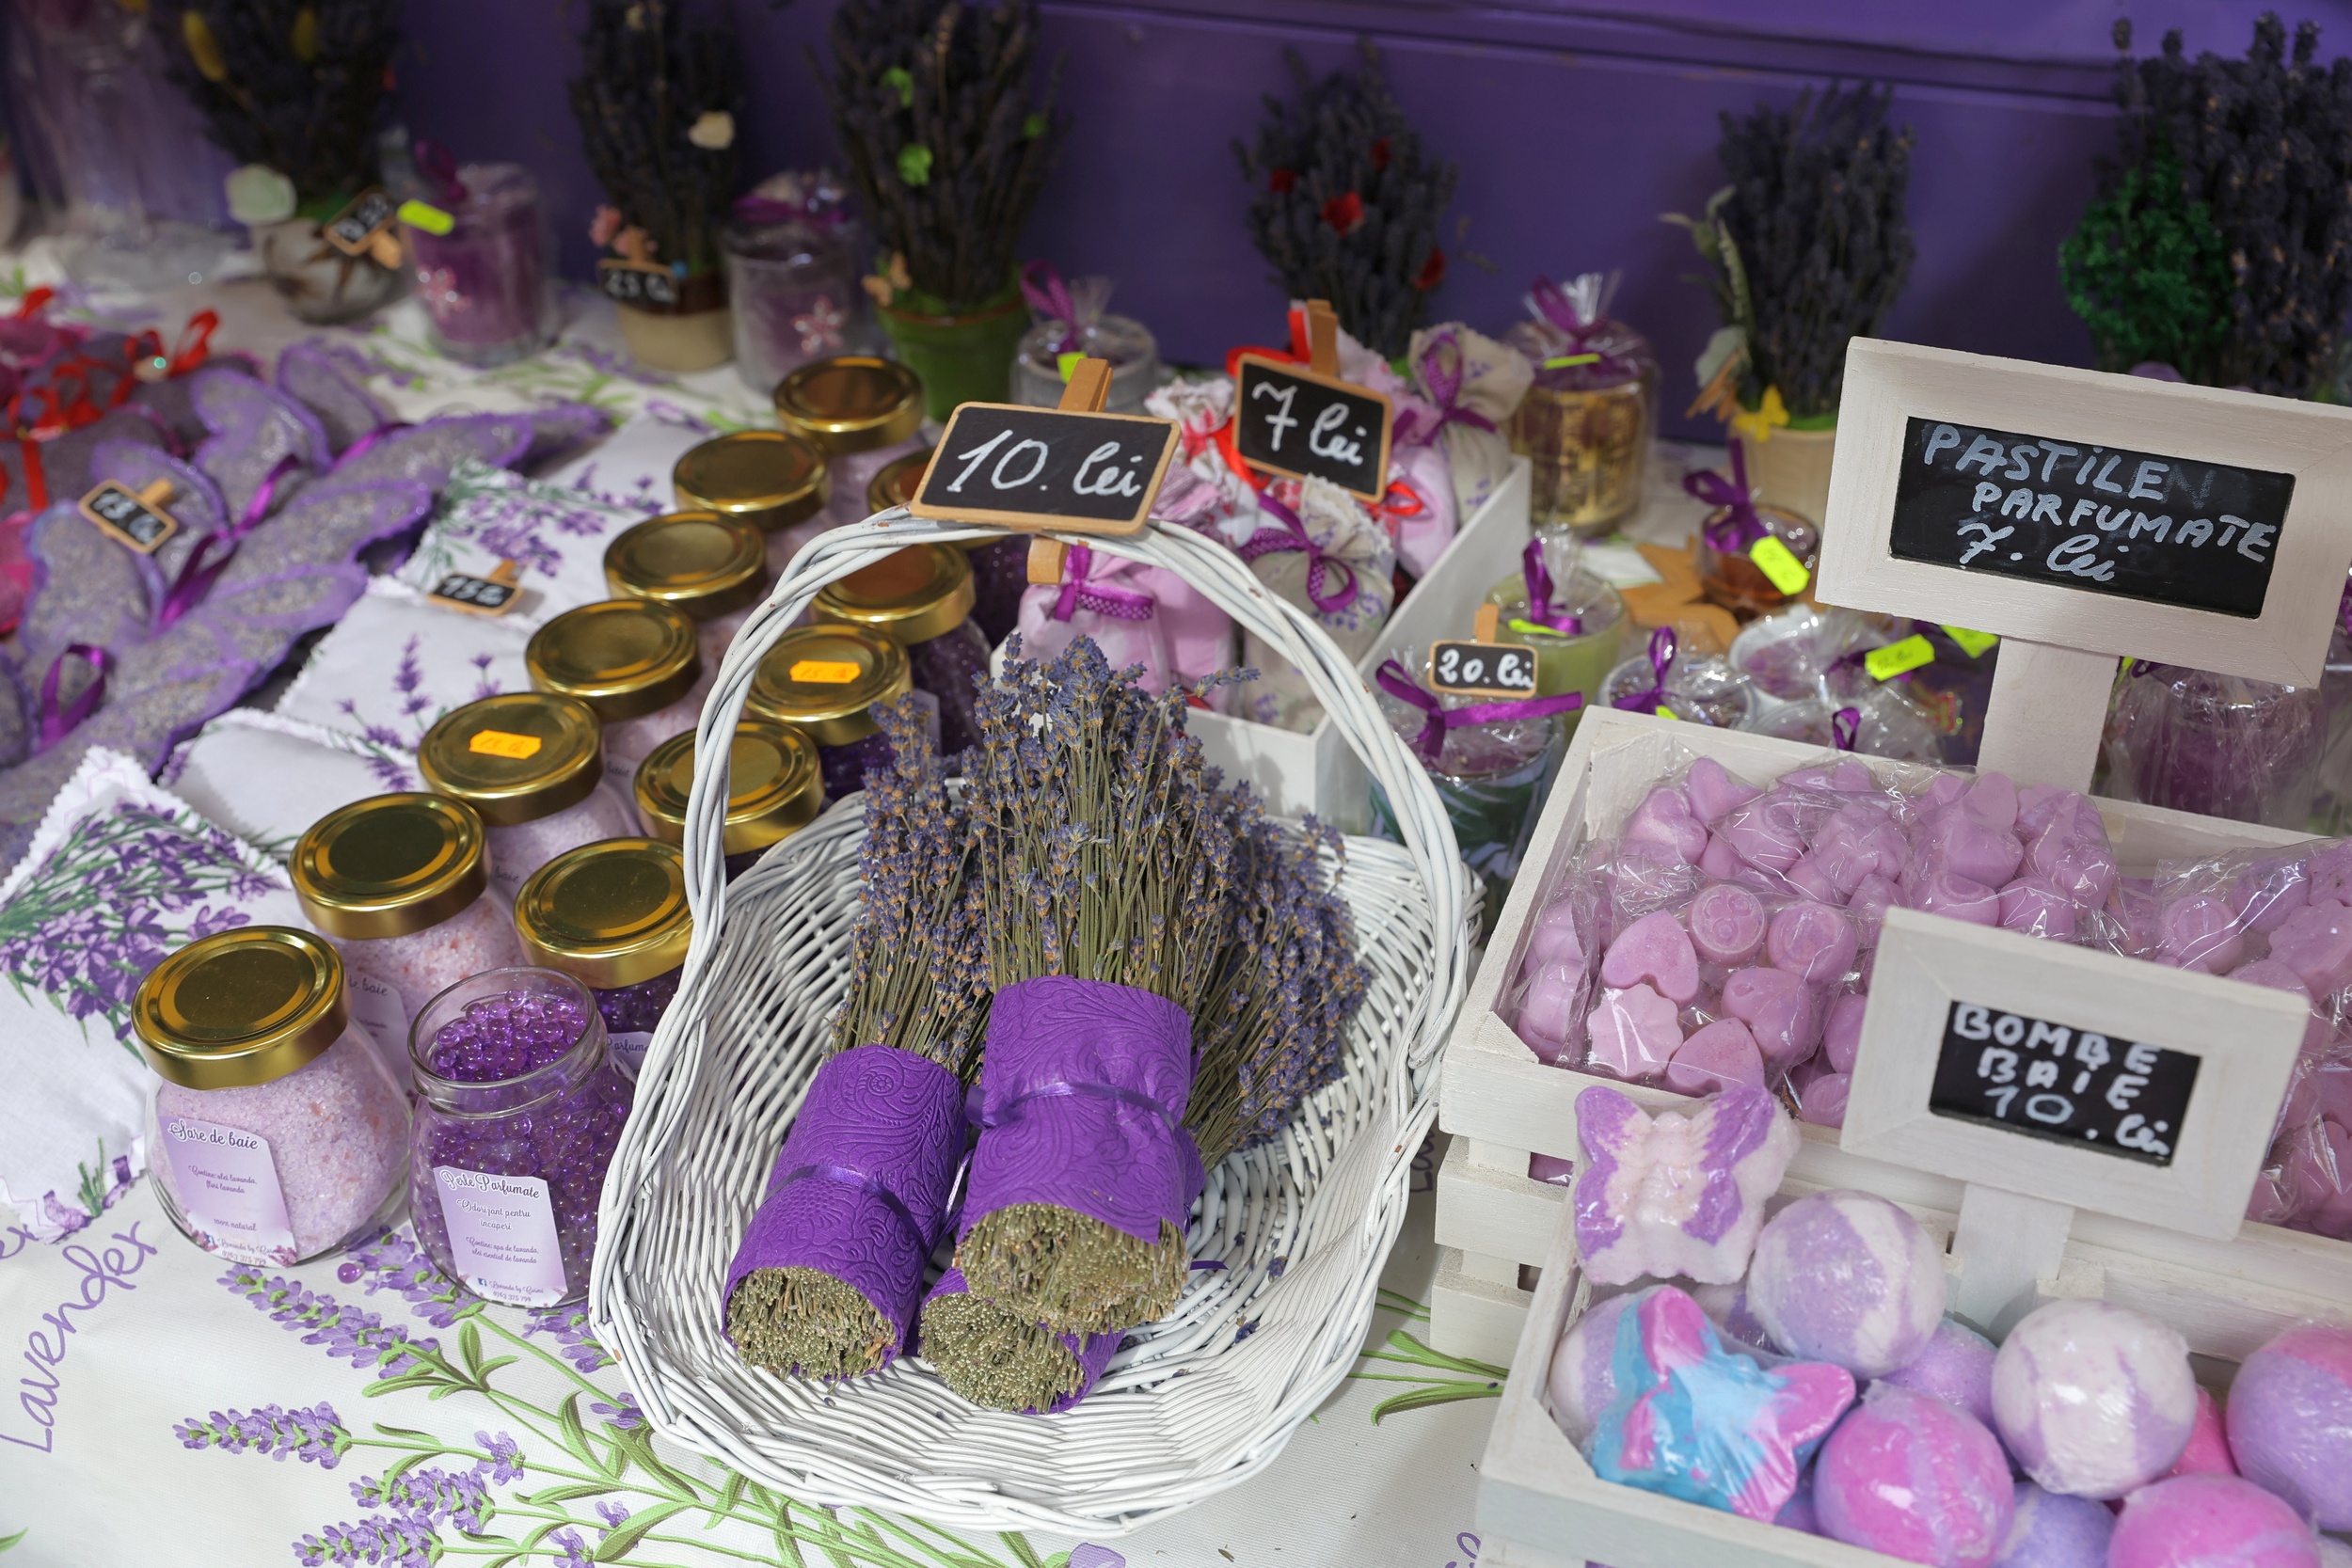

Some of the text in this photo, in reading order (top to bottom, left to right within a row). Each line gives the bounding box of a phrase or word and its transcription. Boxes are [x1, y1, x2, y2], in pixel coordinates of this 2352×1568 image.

[1252, 381, 1367, 466] 7 lei
[946, 429, 1142, 497] 10. lei
[1973, 483, 2276, 562] PARFUMATE
[2047, 533, 2129, 581] lei
[362, 977, 389, 997] baie
[1953, 1003, 2161, 1074] BOMBE
[169, 1120, 259, 1149] Sare de baie
[441, 1171, 540, 1198] Perle Parfumate
[457, 1199, 531, 1218] Odorizant pentru
[230, 1222, 257, 1231] natural
[0, 1221, 157, 1453] Lavender
